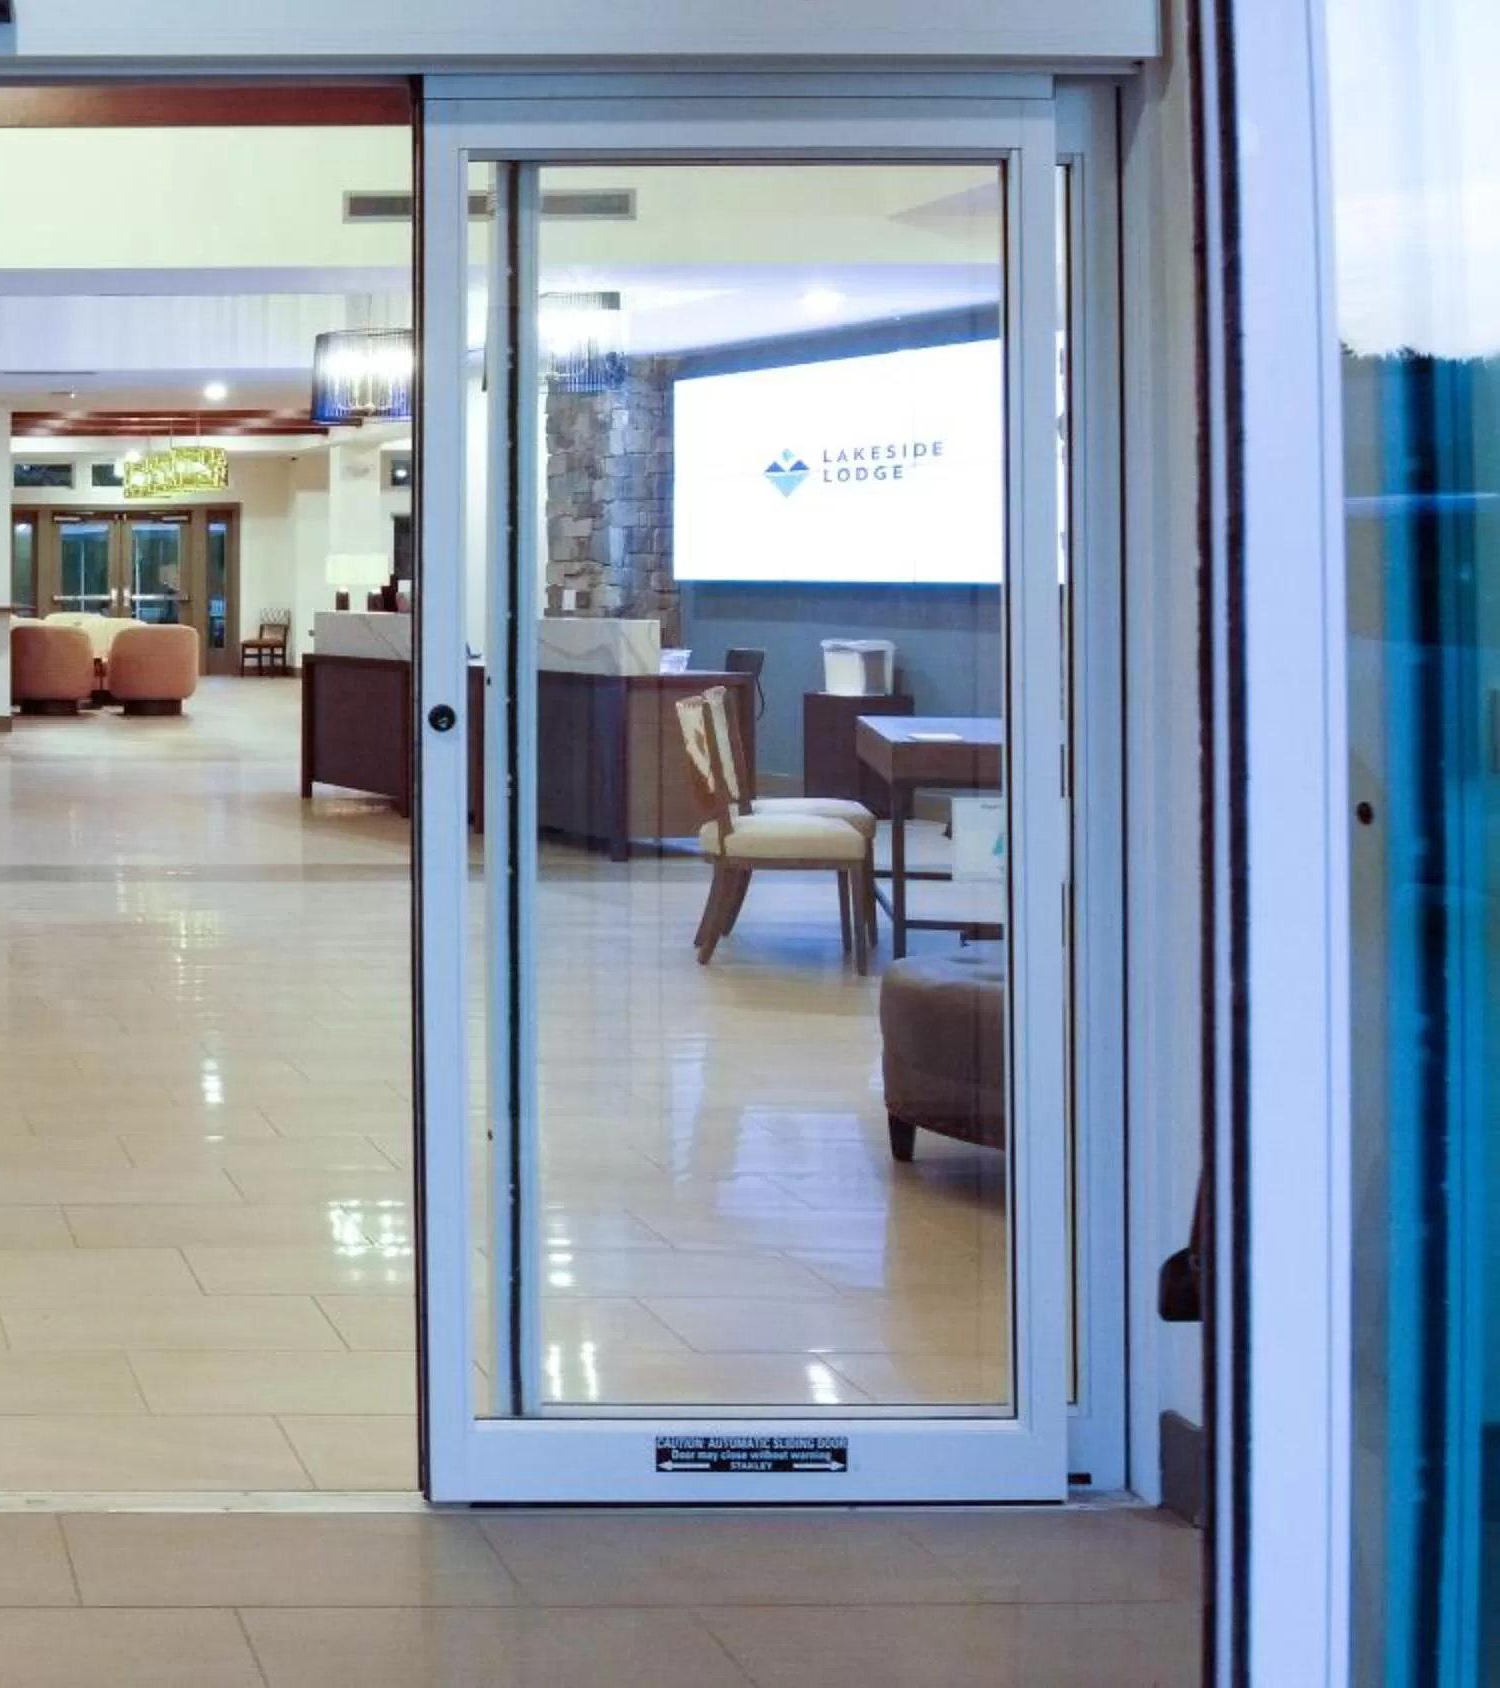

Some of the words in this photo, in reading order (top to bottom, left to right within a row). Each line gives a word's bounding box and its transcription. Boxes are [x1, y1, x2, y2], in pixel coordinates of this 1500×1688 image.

[822, 440, 944, 463] LAKESIDE
[822, 463, 905, 482] LODGE
[707, 1437, 771, 1449] AUTOMATIC
[772, 1437, 816, 1449] SLIDING
[817, 1437, 847, 1449] DOOR
[671, 1449, 694, 1460] Door
[696, 1451, 717, 1462] may
[719, 1449, 747, 1460] close
[749, 1450, 788, 1460] without
[790, 1450, 831, 1462] warning
